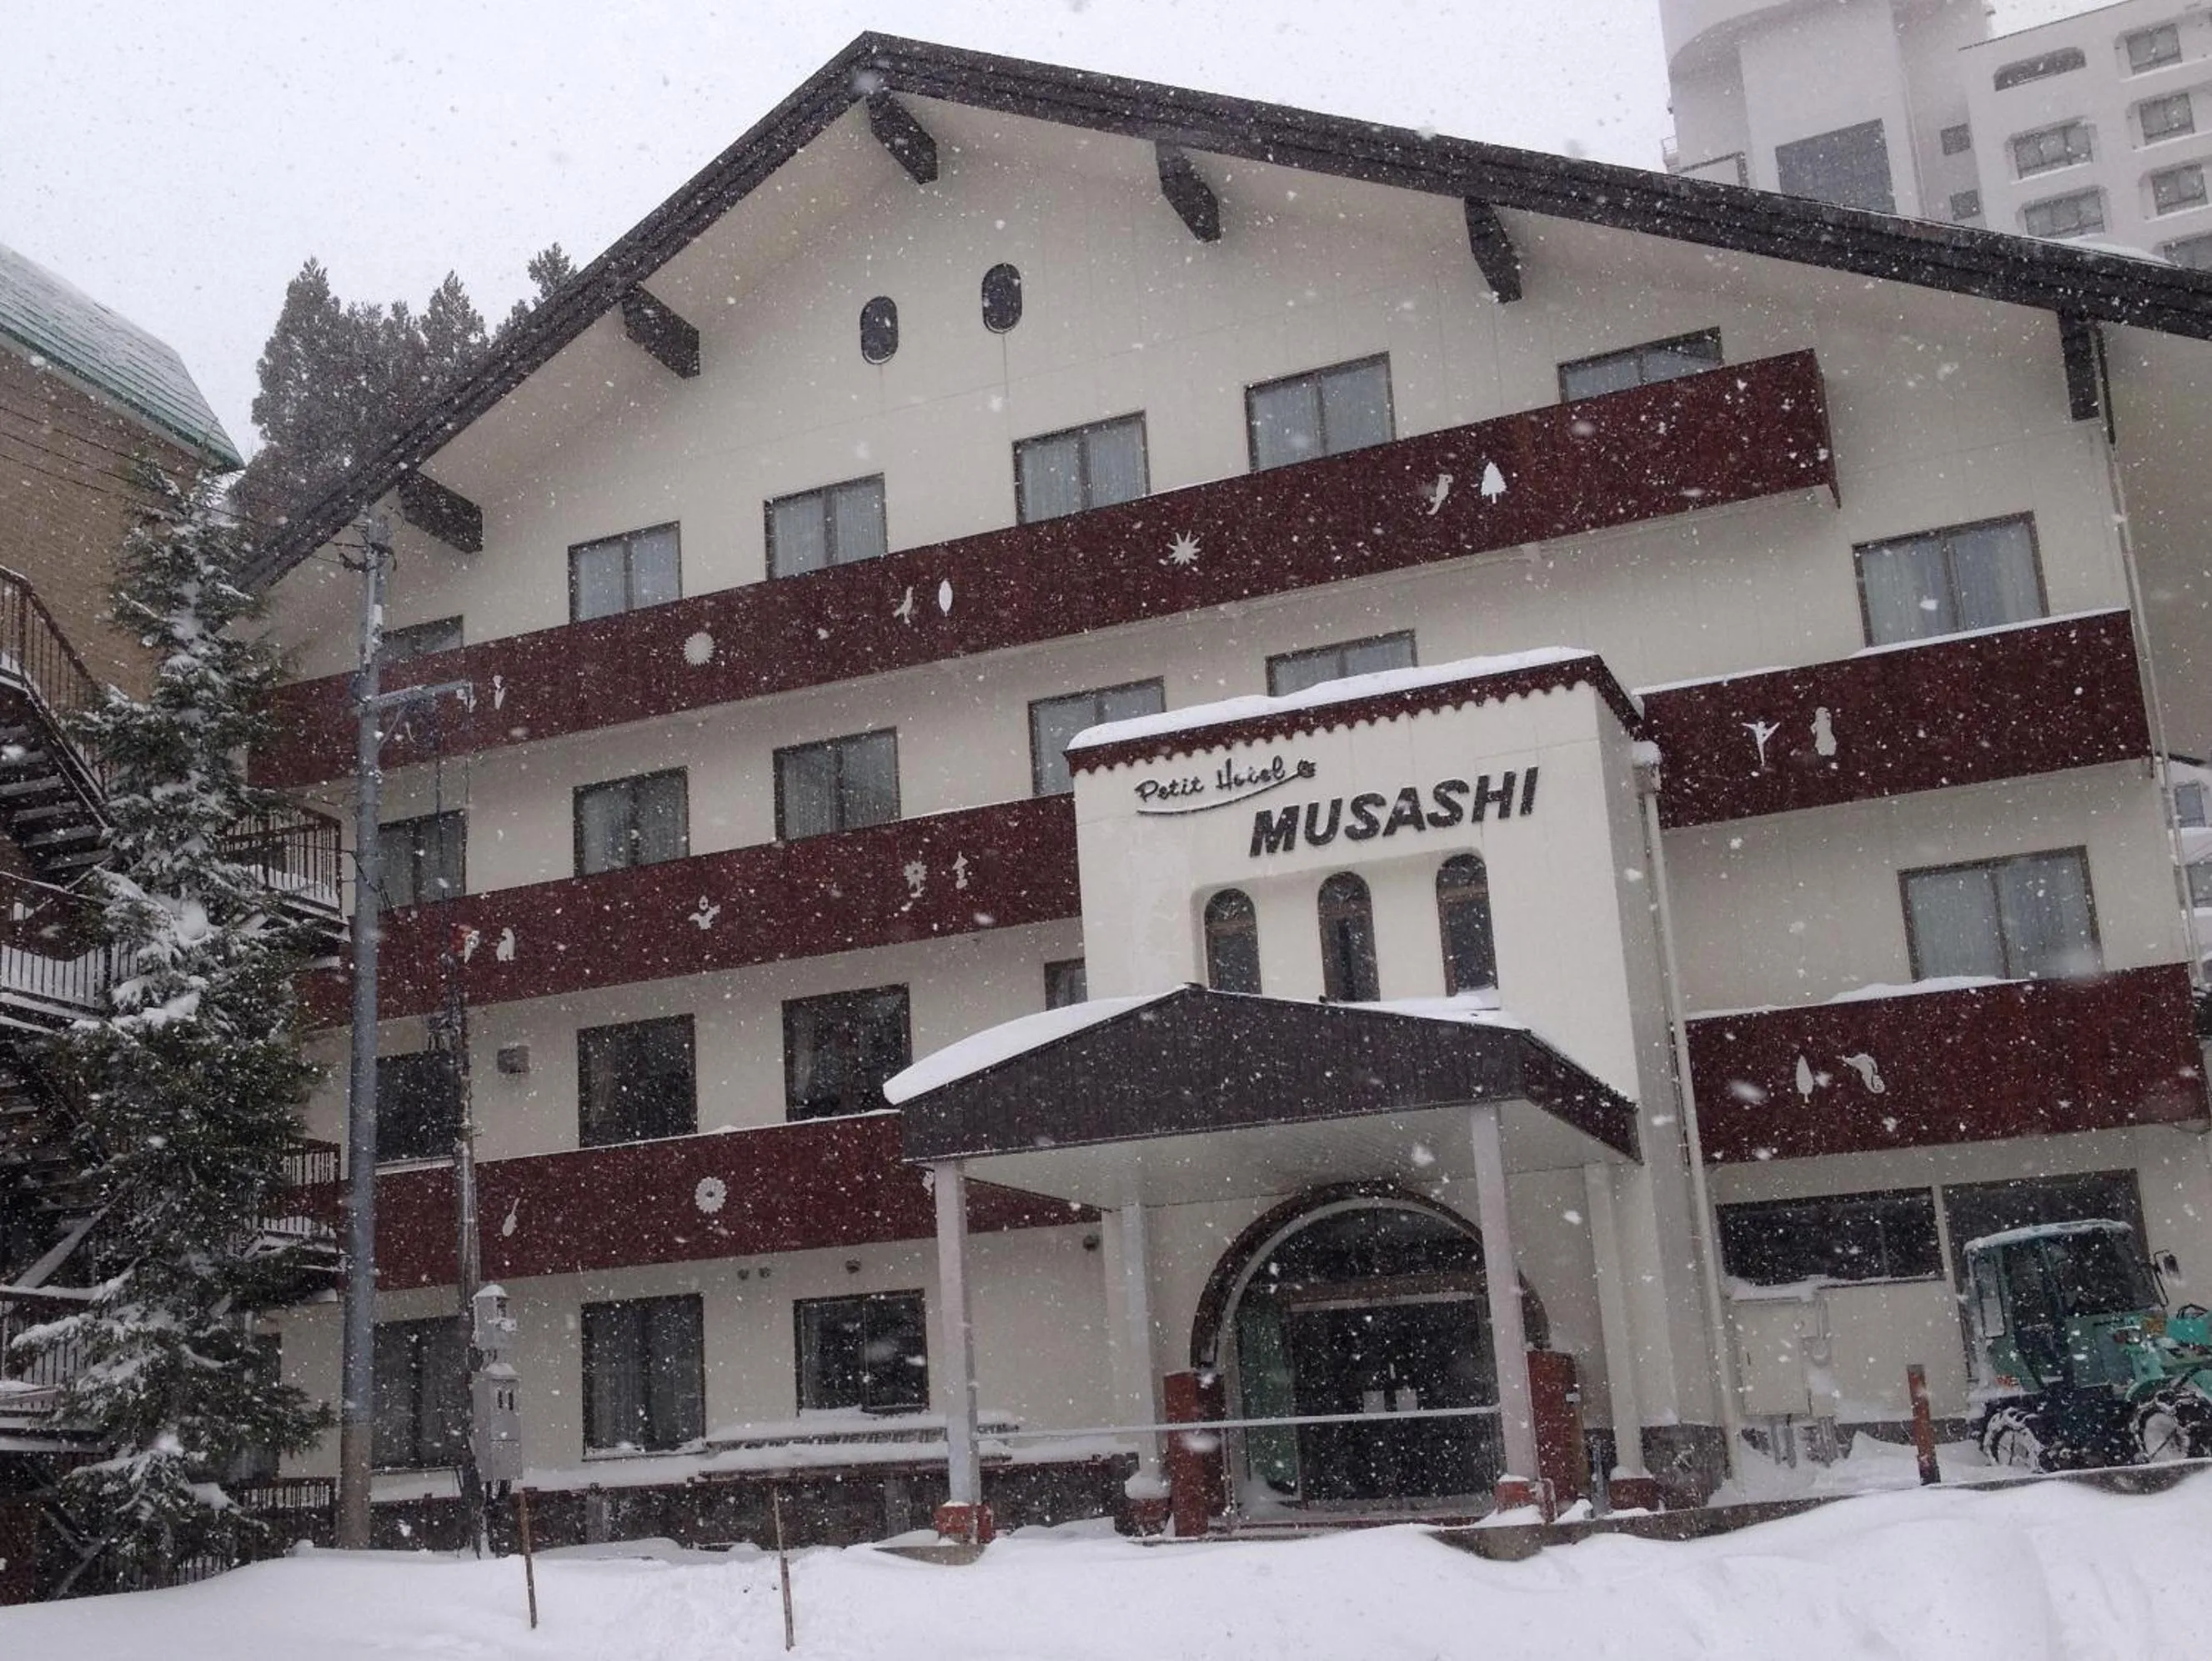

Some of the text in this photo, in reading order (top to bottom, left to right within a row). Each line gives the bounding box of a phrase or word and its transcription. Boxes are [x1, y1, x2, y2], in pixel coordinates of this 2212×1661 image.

[1134, 755, 1286, 802] Petit Hotel
[1250, 766, 1538, 858] MUSASHI
